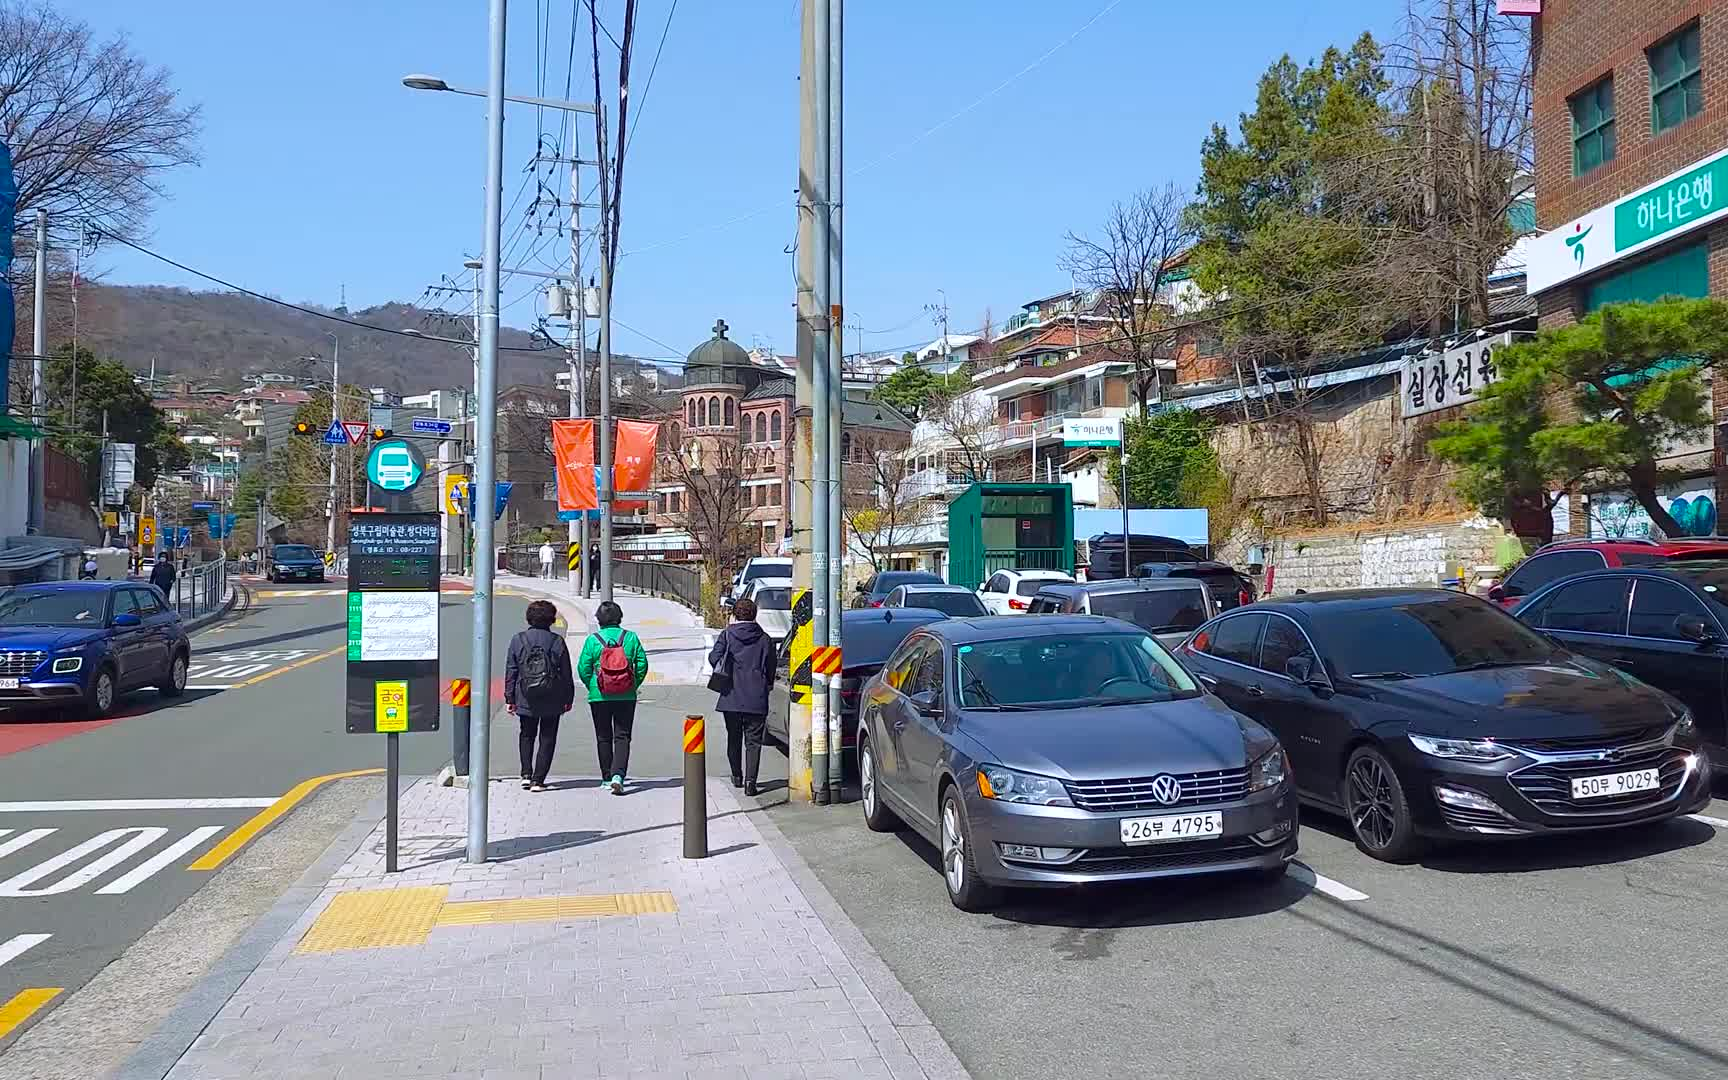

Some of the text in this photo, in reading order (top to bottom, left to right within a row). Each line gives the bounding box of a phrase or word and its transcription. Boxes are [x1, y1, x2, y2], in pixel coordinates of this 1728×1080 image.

[1637, 171, 1713, 232] 하나은행
[1616, 771, 1652, 791] 9029
[1131, 815, 1215, 839] 26부 4795
